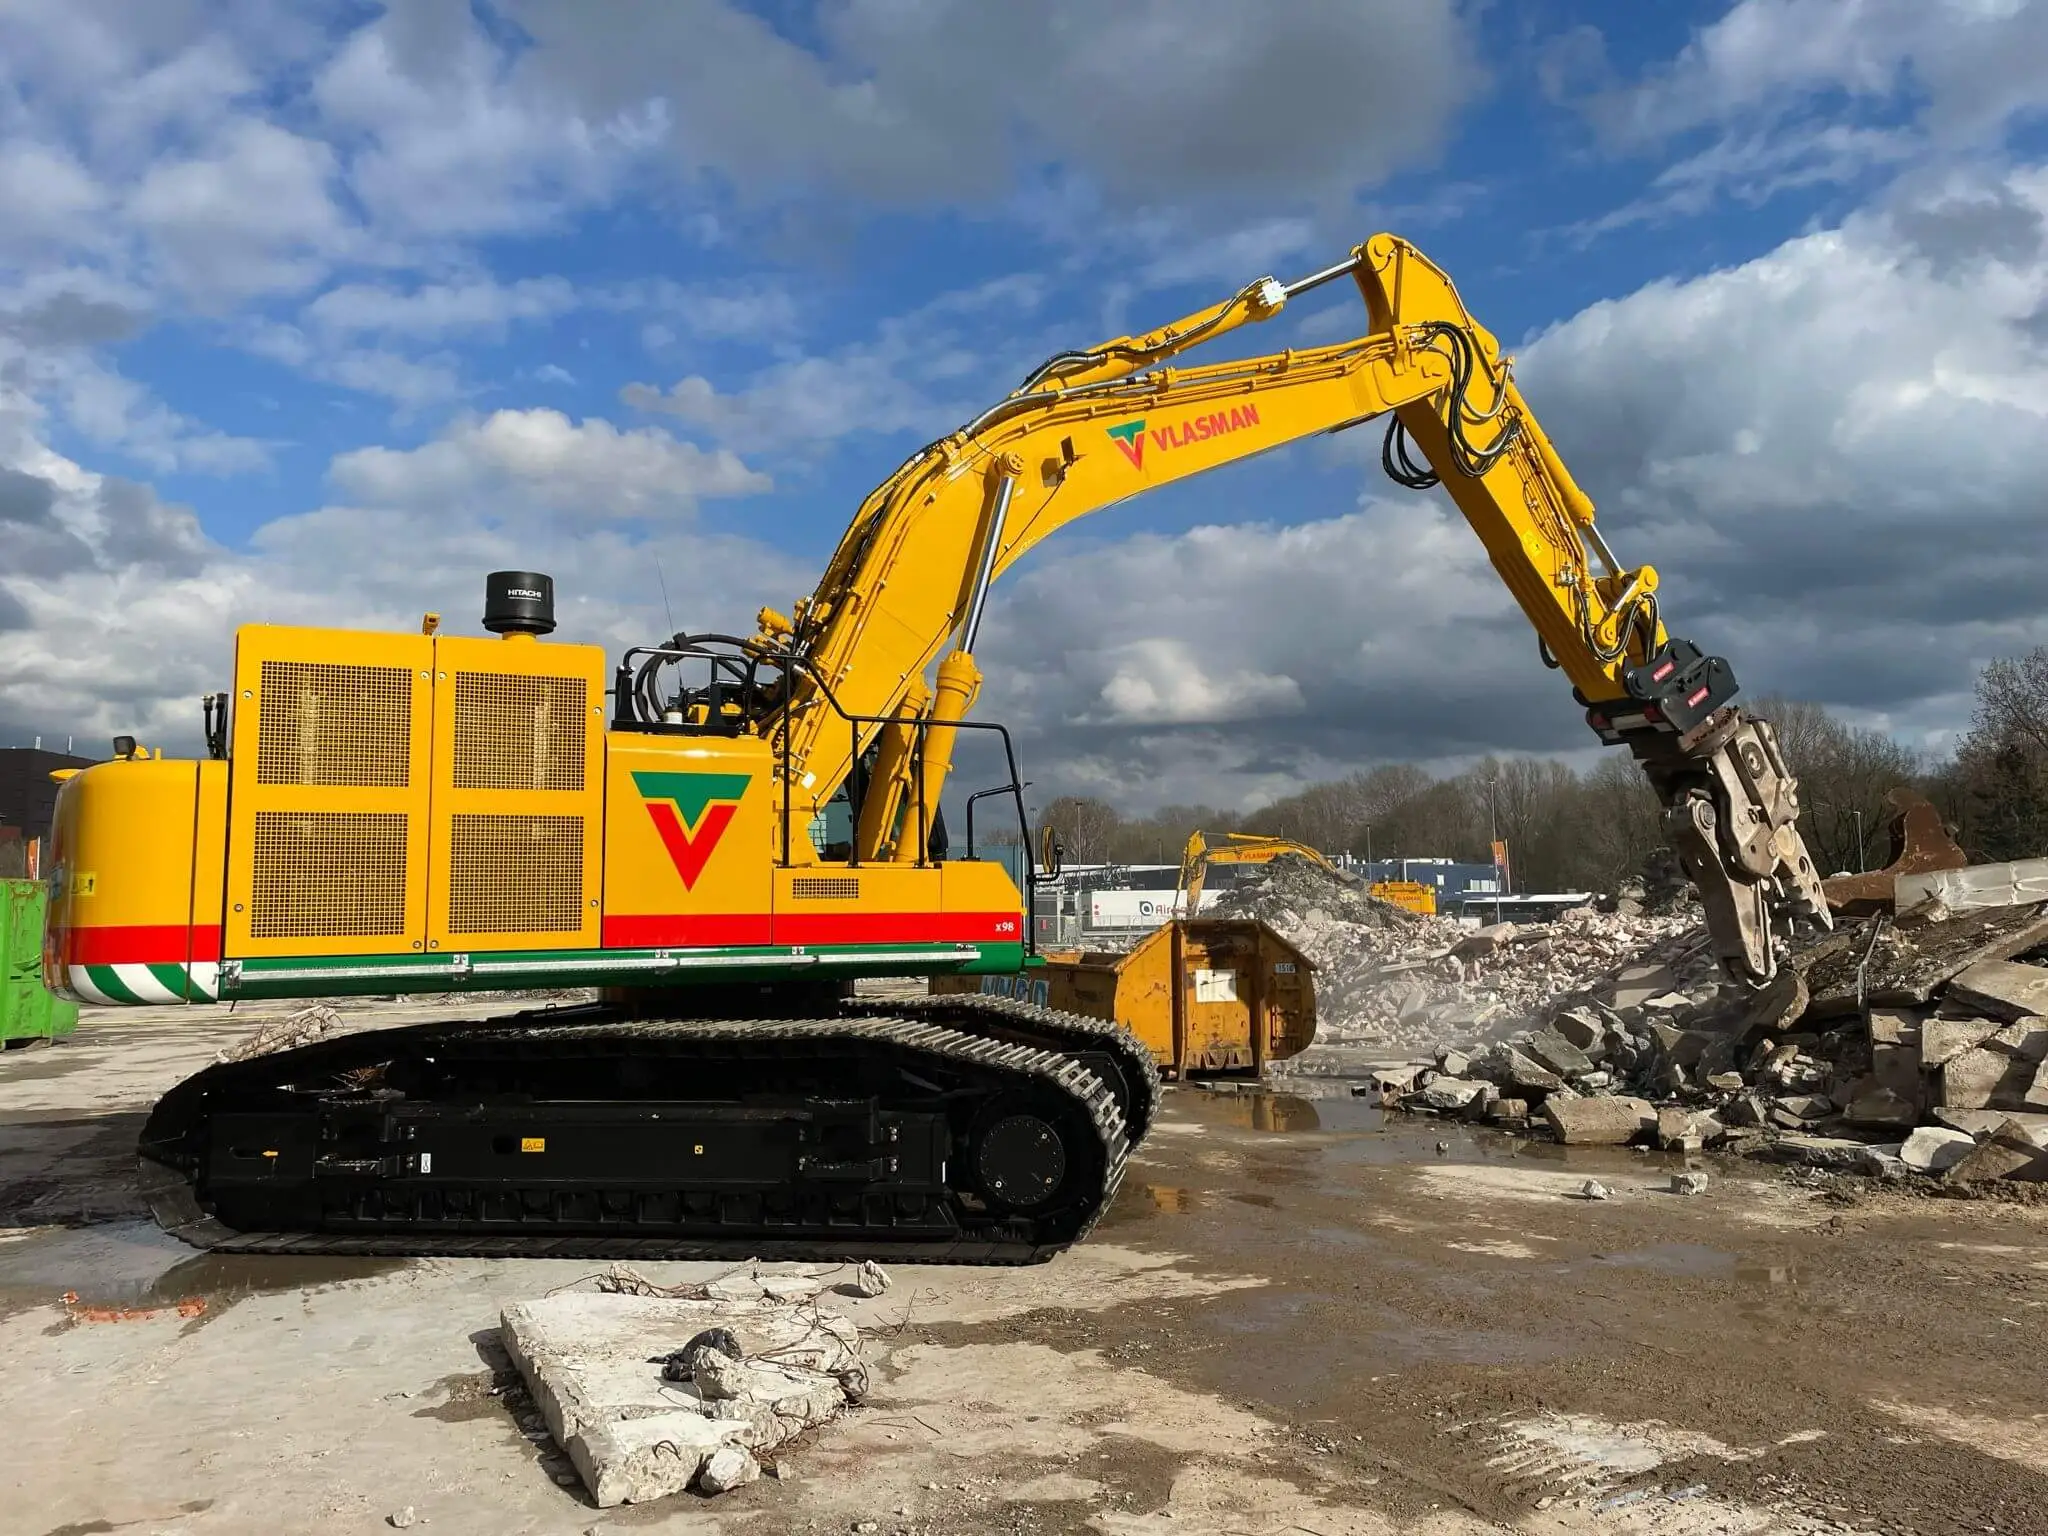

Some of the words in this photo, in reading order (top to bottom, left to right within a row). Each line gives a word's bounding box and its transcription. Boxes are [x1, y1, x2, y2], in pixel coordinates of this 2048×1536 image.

[1151, 404, 1260, 451] VLASMAN
[508, 589, 541, 597] HITACHI
[995, 921, 1015, 932] x98
